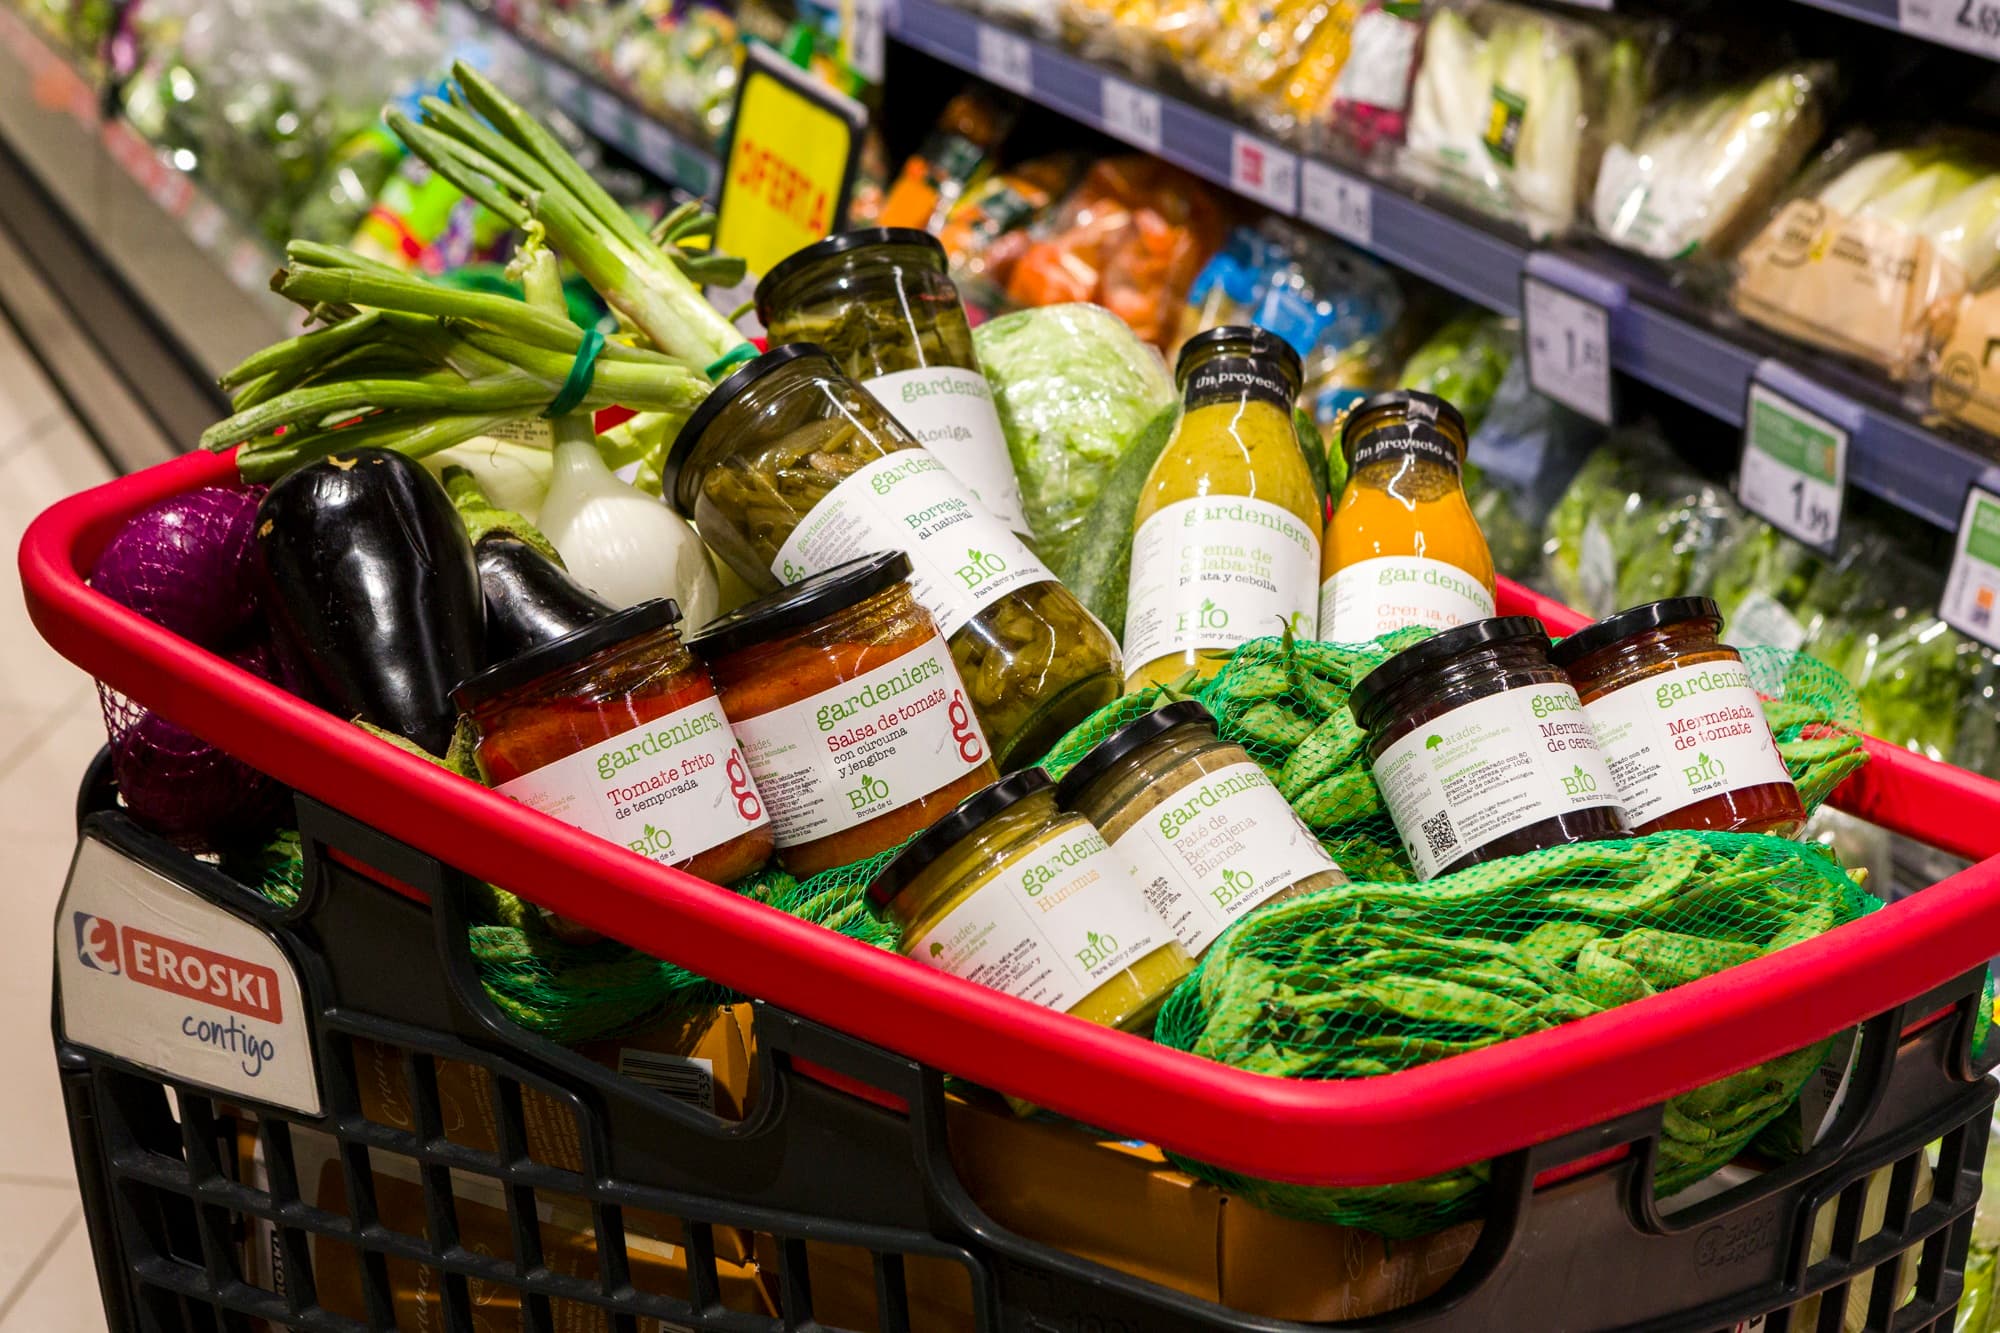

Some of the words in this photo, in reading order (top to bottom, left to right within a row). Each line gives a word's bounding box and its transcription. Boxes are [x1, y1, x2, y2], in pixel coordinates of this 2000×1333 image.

[735, 139, 829, 239] OFERTA
[1355, 447, 1373, 462] Un
[1375, 438, 1443, 455] proyecto
[904, 498, 967, 529] Borraja
[918, 527, 933, 541] al
[933, 509, 975, 534] natural
[955, 550, 1006, 590] BIO
[1250, 549, 1273, 564] de
[974, 585, 992, 599] Para
[1223, 573, 1232, 583] y
[1234, 574, 1278, 593] cebolla
[816, 657, 945, 731] gardeniers,
[827, 723, 877, 752] Salsa
[877, 712, 899, 731] de
[899, 688, 947, 721] tomate
[1667, 704, 1755, 737] Mermelada
[1674, 733, 1697, 751] de
[1700, 722, 1753, 743] tomate
[597, 711, 723, 780] gardeniers,
[834, 749, 856, 764] con
[857, 726, 908, 755] cúrcuma
[1547, 738, 1567, 752] de
[838, 768, 848, 779] y
[848, 746, 897, 775] jengibre
[1682, 756, 1726, 787] BIO
[607, 767, 680, 807] Tomate
[680, 753, 715, 777] frito
[846, 777, 889, 810] BIO
[1561, 771, 1597, 796] BIO
[1691, 783, 1712, 796] Brota
[1712, 780, 1722, 788] de
[615, 808, 631, 820] de
[631, 778, 698, 813] temporada
[856, 806, 877, 819] Brota
[877, 801, 887, 810] de
[887, 799, 894, 807] ti
[628, 827, 672, 859] BIO
[1173, 824, 1206, 856] Paté
[1208, 814, 1230, 832] de
[1183, 816, 1258, 868] Berenjena
[1192, 840, 1247, 880] Blanca
[1036, 869, 1100, 913] Hummus
[1211, 868, 1255, 908] BIO
[1226, 901, 1243, 915] Para
[1242, 889, 1260, 904] abrir
[1075, 931, 1118, 971] BIO
[133, 940, 270, 1010] EROSKI
[1090, 965, 1108, 979] Para
[182, 1016, 275, 1077] contigo
